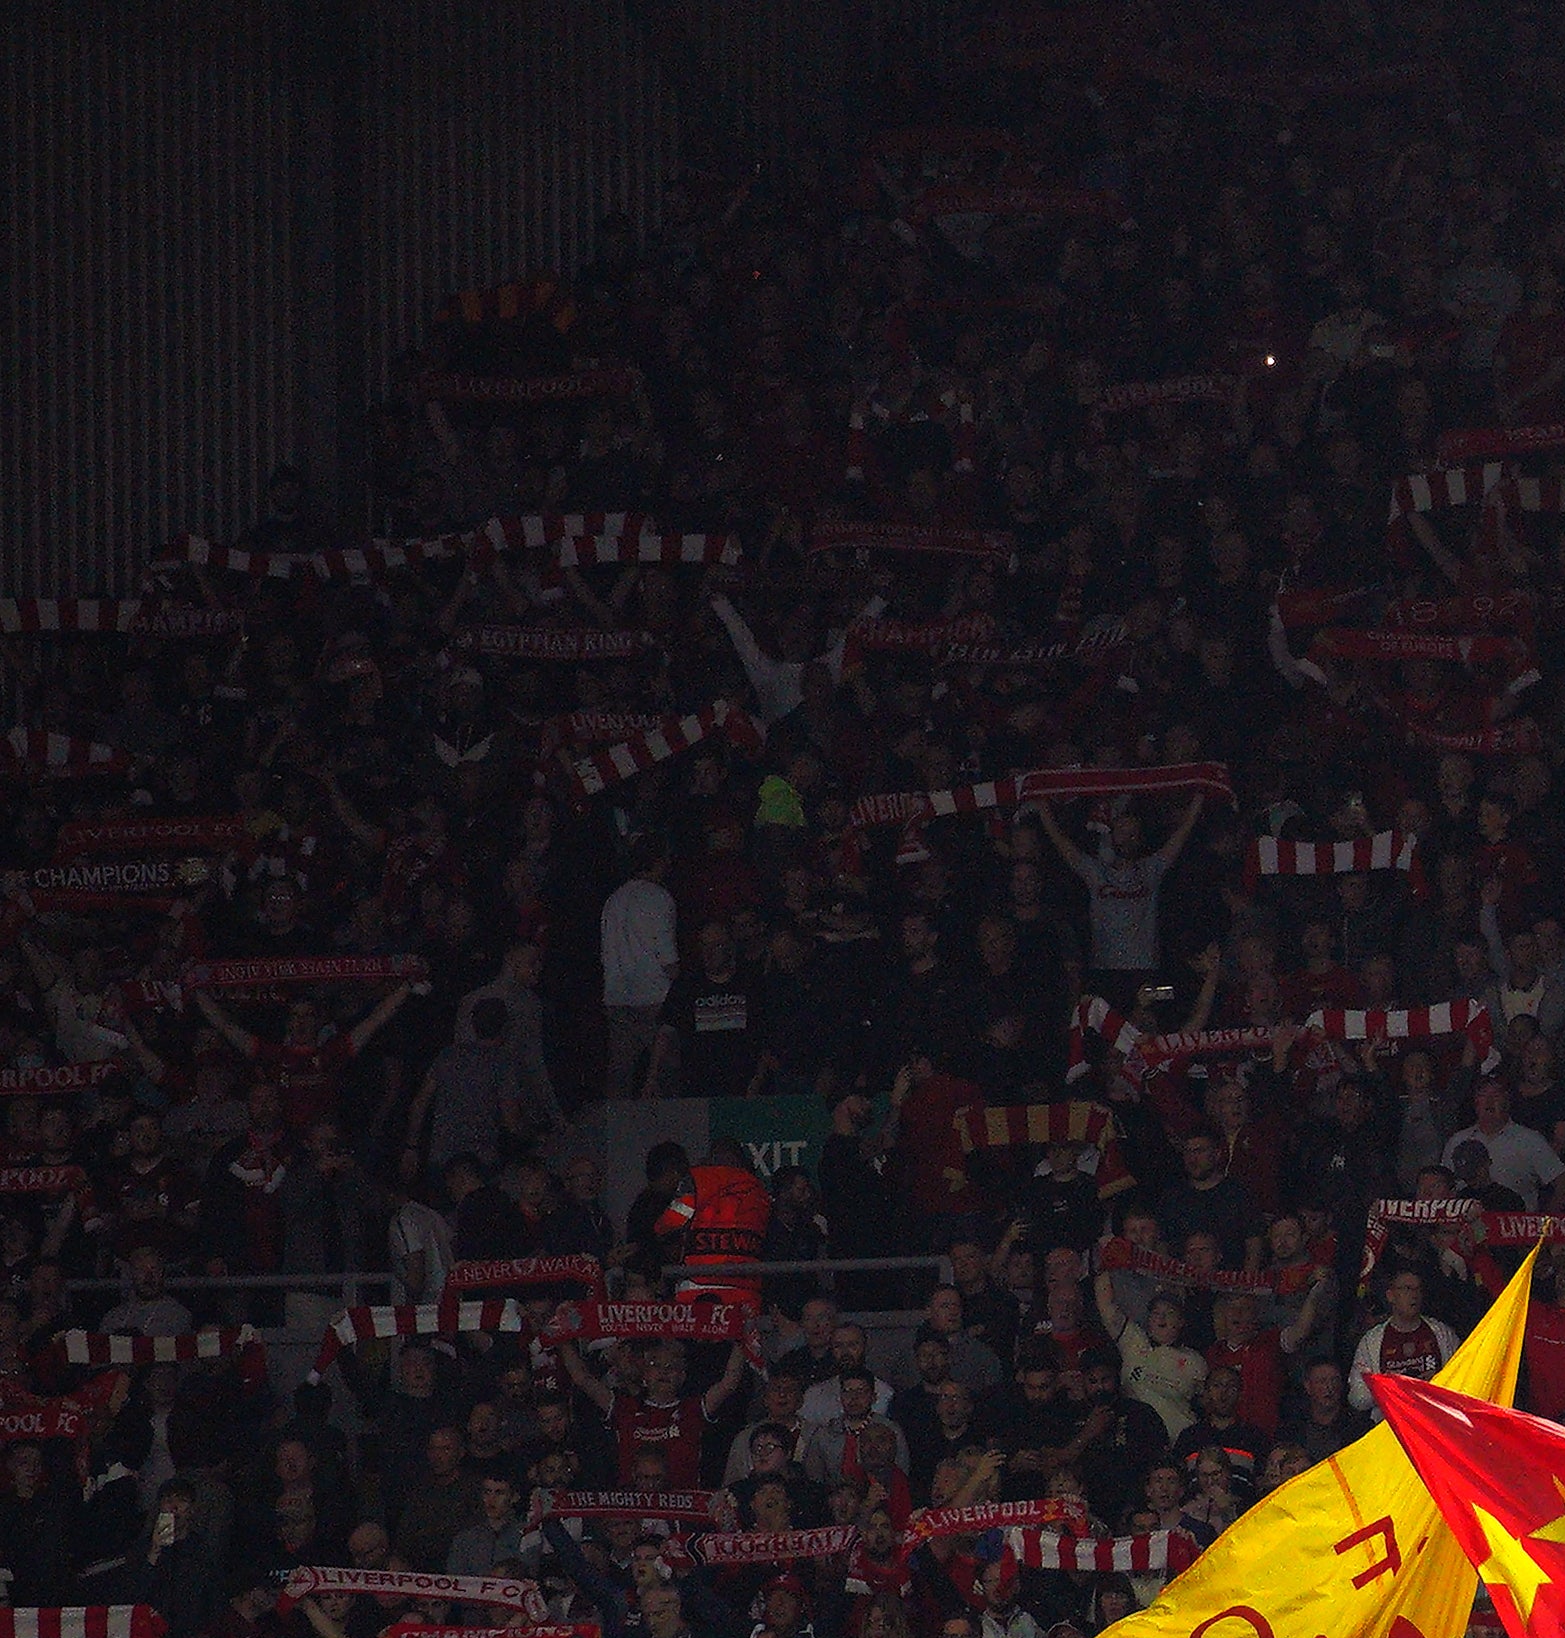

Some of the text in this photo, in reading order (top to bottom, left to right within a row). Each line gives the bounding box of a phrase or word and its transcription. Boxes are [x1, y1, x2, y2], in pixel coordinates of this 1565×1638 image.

[584, 632, 633, 654] KING
[66, 823, 204, 846] LIVERPOOL
[34, 862, 169, 889] CHAMPIONS
[745, 1139, 808, 1177] XIT
[462, 1262, 512, 1281] NEVER
[539, 1255, 580, 1275] WALK
[597, 1303, 735, 1325] LIVERPOOL FC
[635, 1324, 664, 1334] NEVER
[699, 1325, 730, 1336] ALONE
[567, 1489, 693, 1510] THE MIGHTY REDS
[928, 1501, 1041, 1530] LIVERPOOL
[326, 1568, 466, 1593] LIVERPOOL
